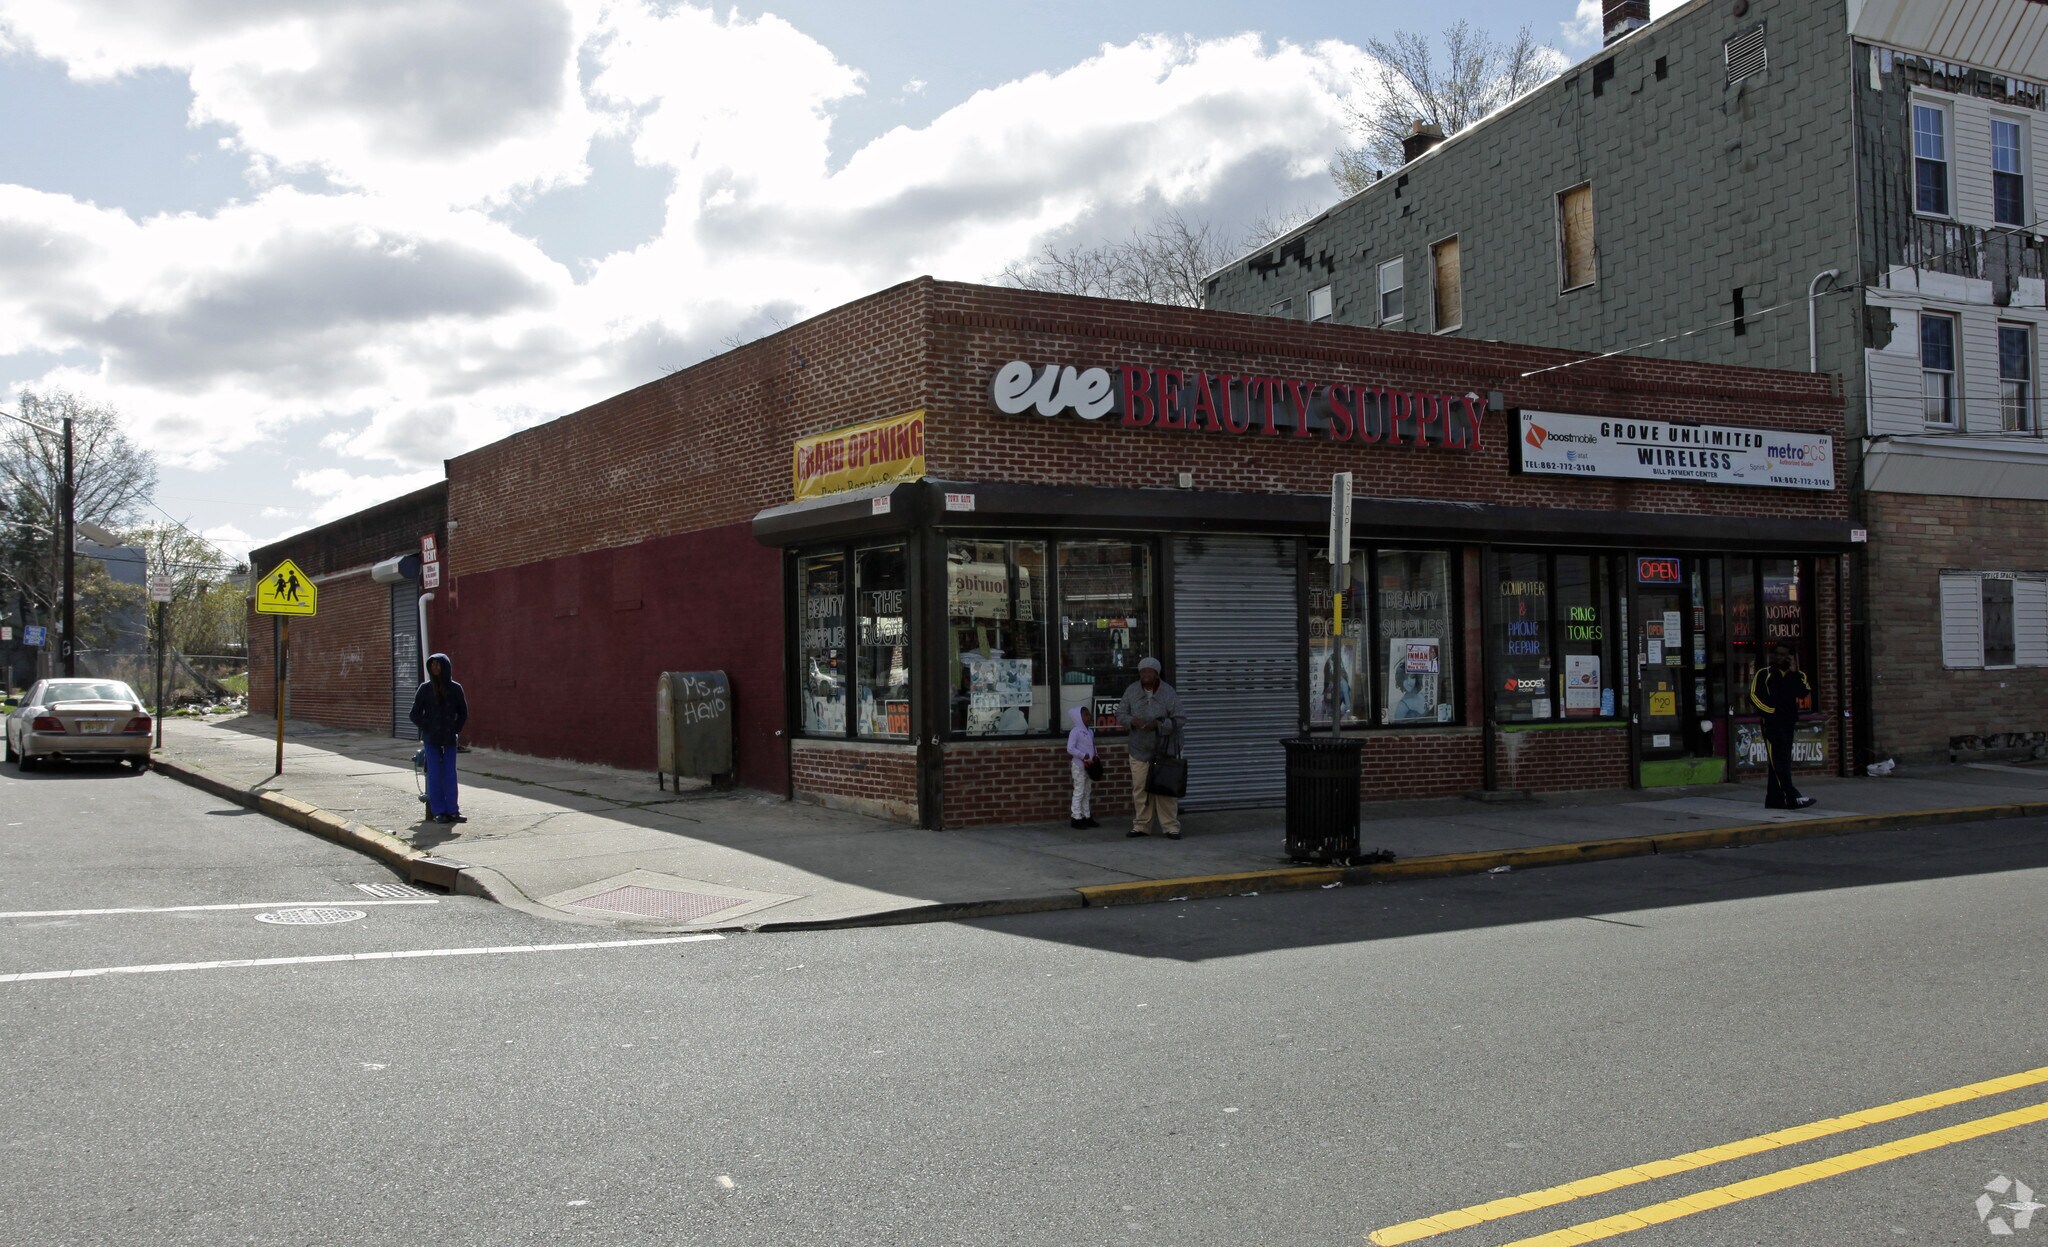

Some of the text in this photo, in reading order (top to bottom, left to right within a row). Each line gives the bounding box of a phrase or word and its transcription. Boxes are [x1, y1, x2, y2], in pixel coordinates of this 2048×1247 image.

[993, 360, 1488, 451] eve BEAUTY SUPPLY
[1600, 422, 1763, 448] GROVE UNLIMITED
[797, 419, 923, 481] GRAND OPENING
[1637, 448, 1731, 470] WIRELESS
[1667, 469, 1695, 477] PAYMENT
[1750, 463, 1765, 472] Sprint
[423, 536, 434, 550] FOR
[423, 549, 436, 563] RENT
[1640, 561, 1678, 580] OPEN
[1502, 580, 1545, 596] COMPUTER
[807, 594, 844, 620] BEAUTY
[872, 590, 902, 614] THE
[1385, 590, 1439, 610] BEAUTY
[1519, 601, 1527, 616] &
[1570, 606, 1596, 622] RING
[1765, 604, 1801, 619] NOTARY
[862, 622, 909, 646] ROOTS
[1382, 617, 1445, 639] SUPPLIES
[1508, 621, 1539, 637] PHONE
[1567, 625, 1603, 640] TONES
[1768, 623, 1800, 637] PUBLIC
[1508, 640, 1541, 655] REPAIR
[1408, 652, 1428, 660] INMAN
[1518, 677, 1546, 688] boost
[1097, 703, 1120, 715] YES
[888, 714, 909, 734] OPE
